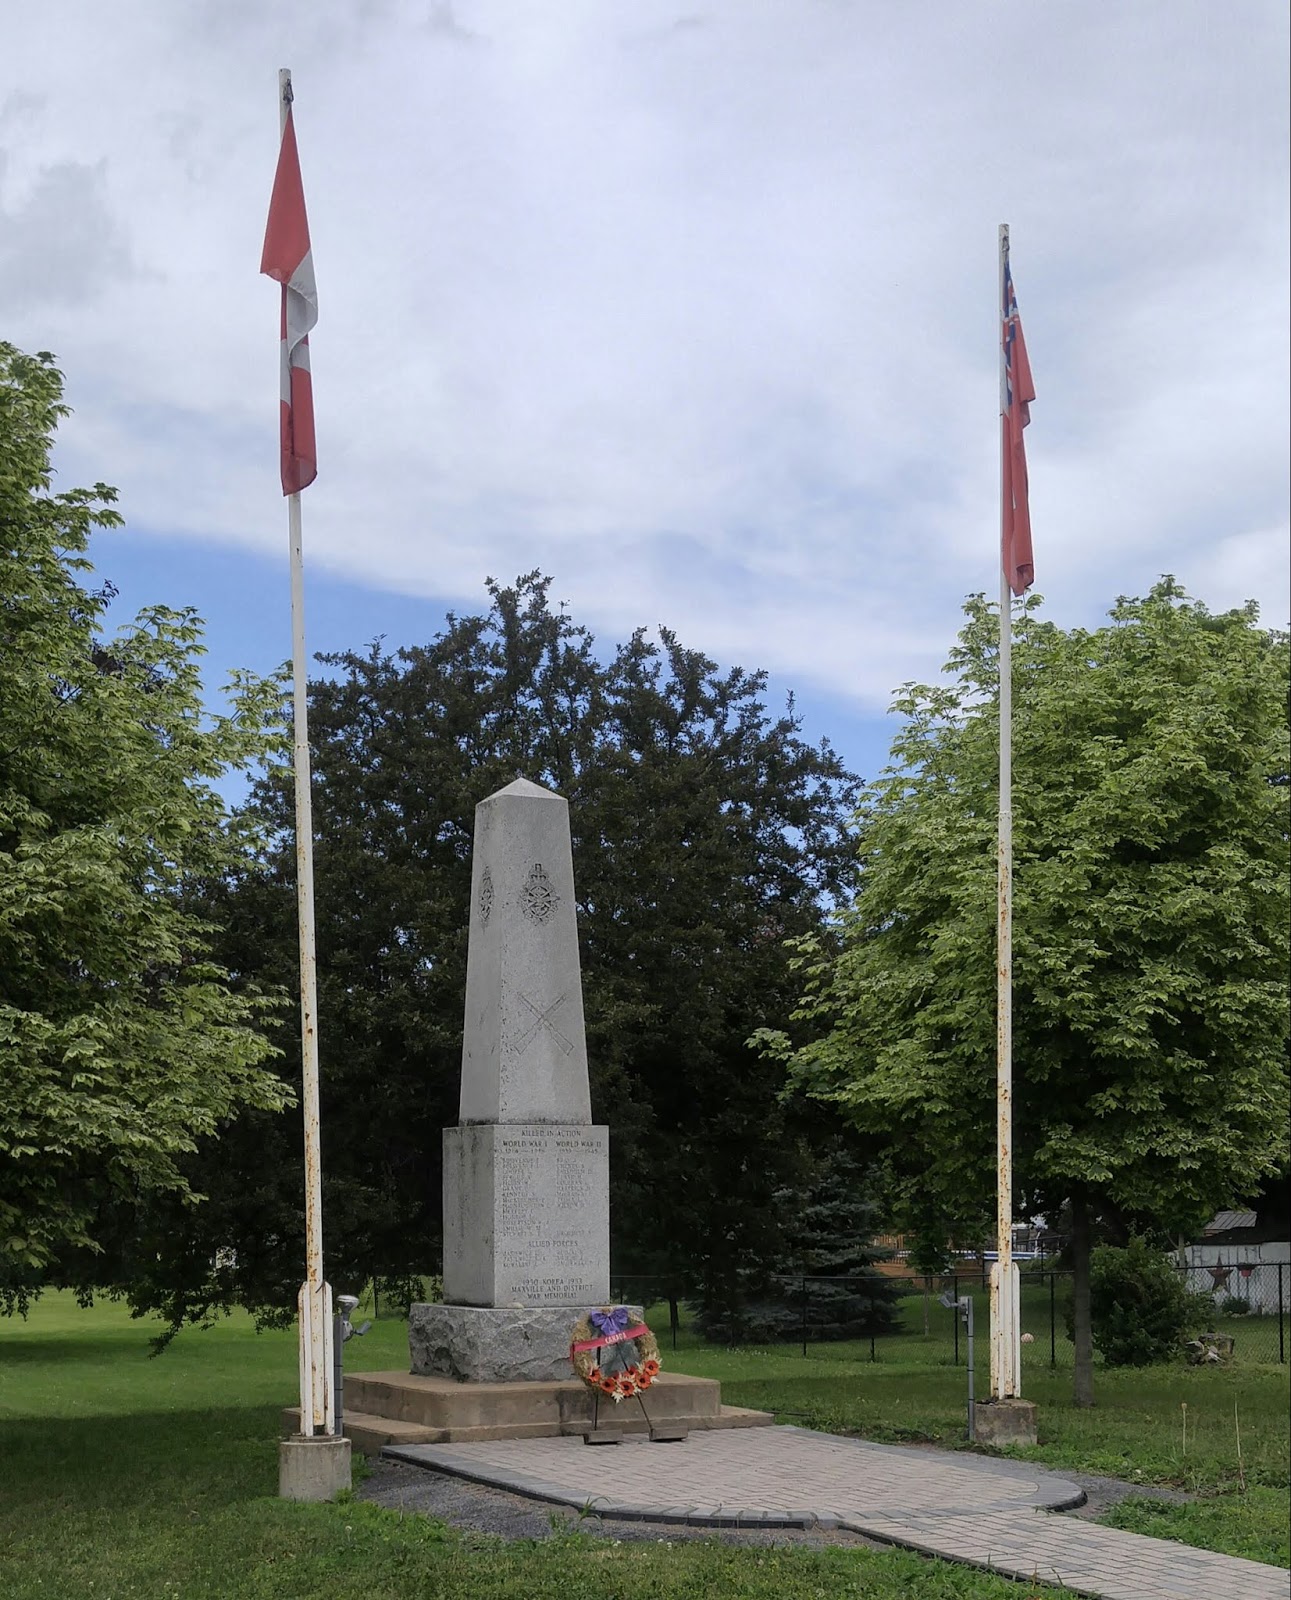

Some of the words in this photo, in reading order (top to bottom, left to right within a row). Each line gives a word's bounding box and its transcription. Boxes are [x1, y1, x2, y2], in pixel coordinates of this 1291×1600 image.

[563, 1284, 593, 1292] DISTRICT
[544, 1292, 577, 1300] MEMORIAL
[604, 1332, 627, 1344] CANADA
